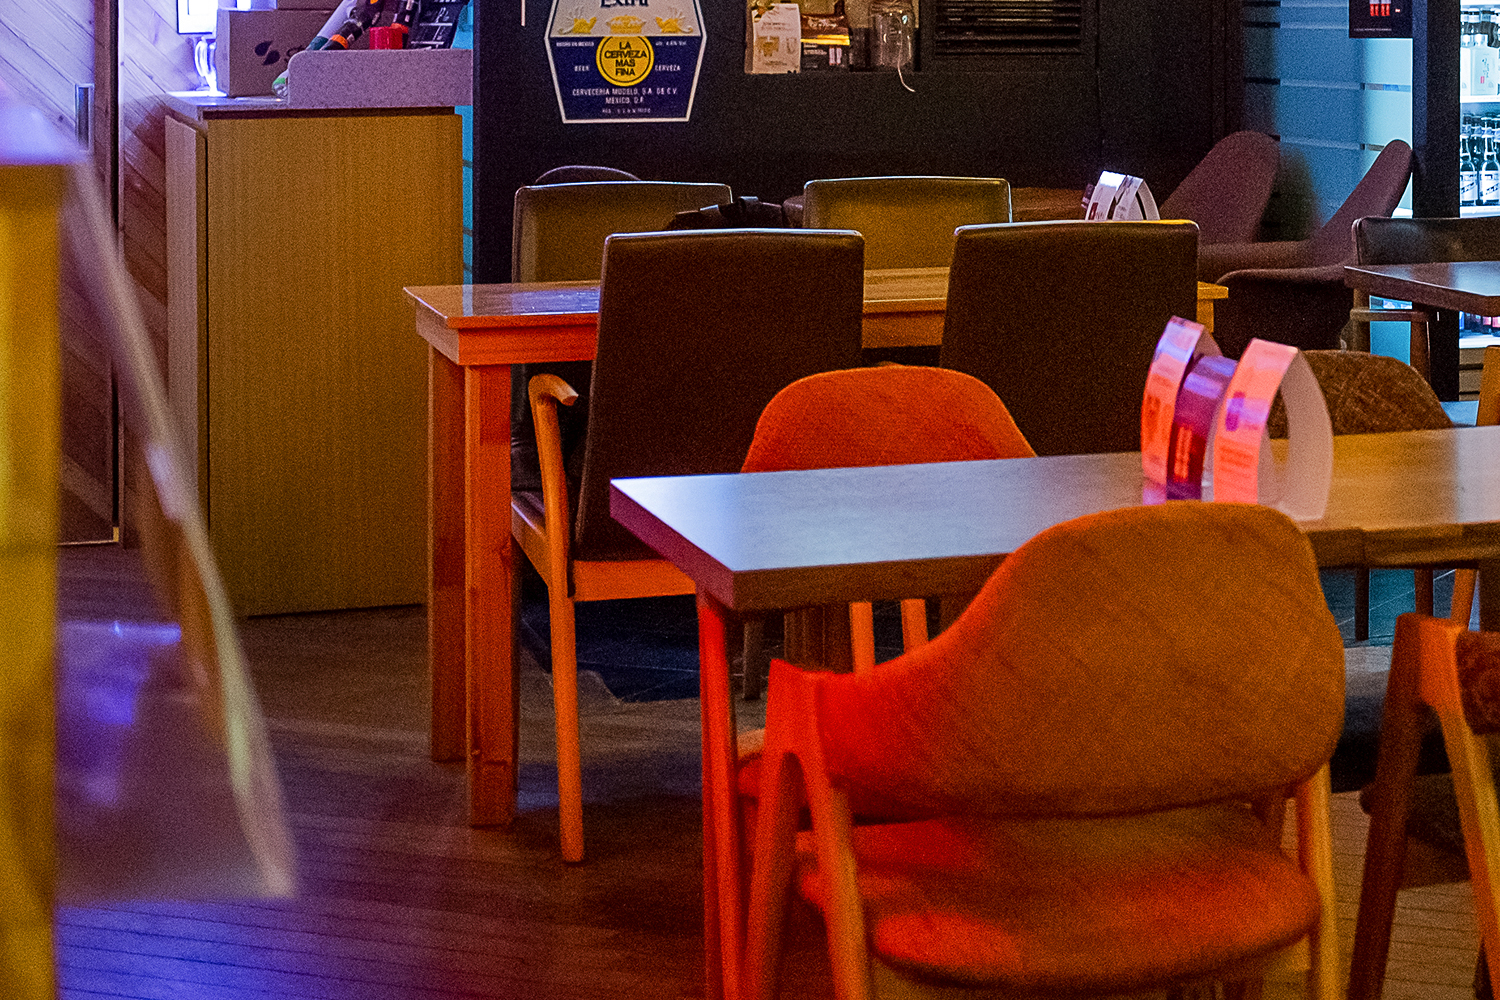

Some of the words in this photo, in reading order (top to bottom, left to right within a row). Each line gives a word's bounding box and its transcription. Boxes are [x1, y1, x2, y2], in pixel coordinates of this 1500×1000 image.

[619, 41, 632, 49] LA
[604, 50, 648, 59] CERVEZA
[615, 59, 636, 67] MAS
[615, 68, 636, 76] FINA
[654, 64, 681, 72] CERVEZA
[572, 88, 610, 97] CERVECERIA
